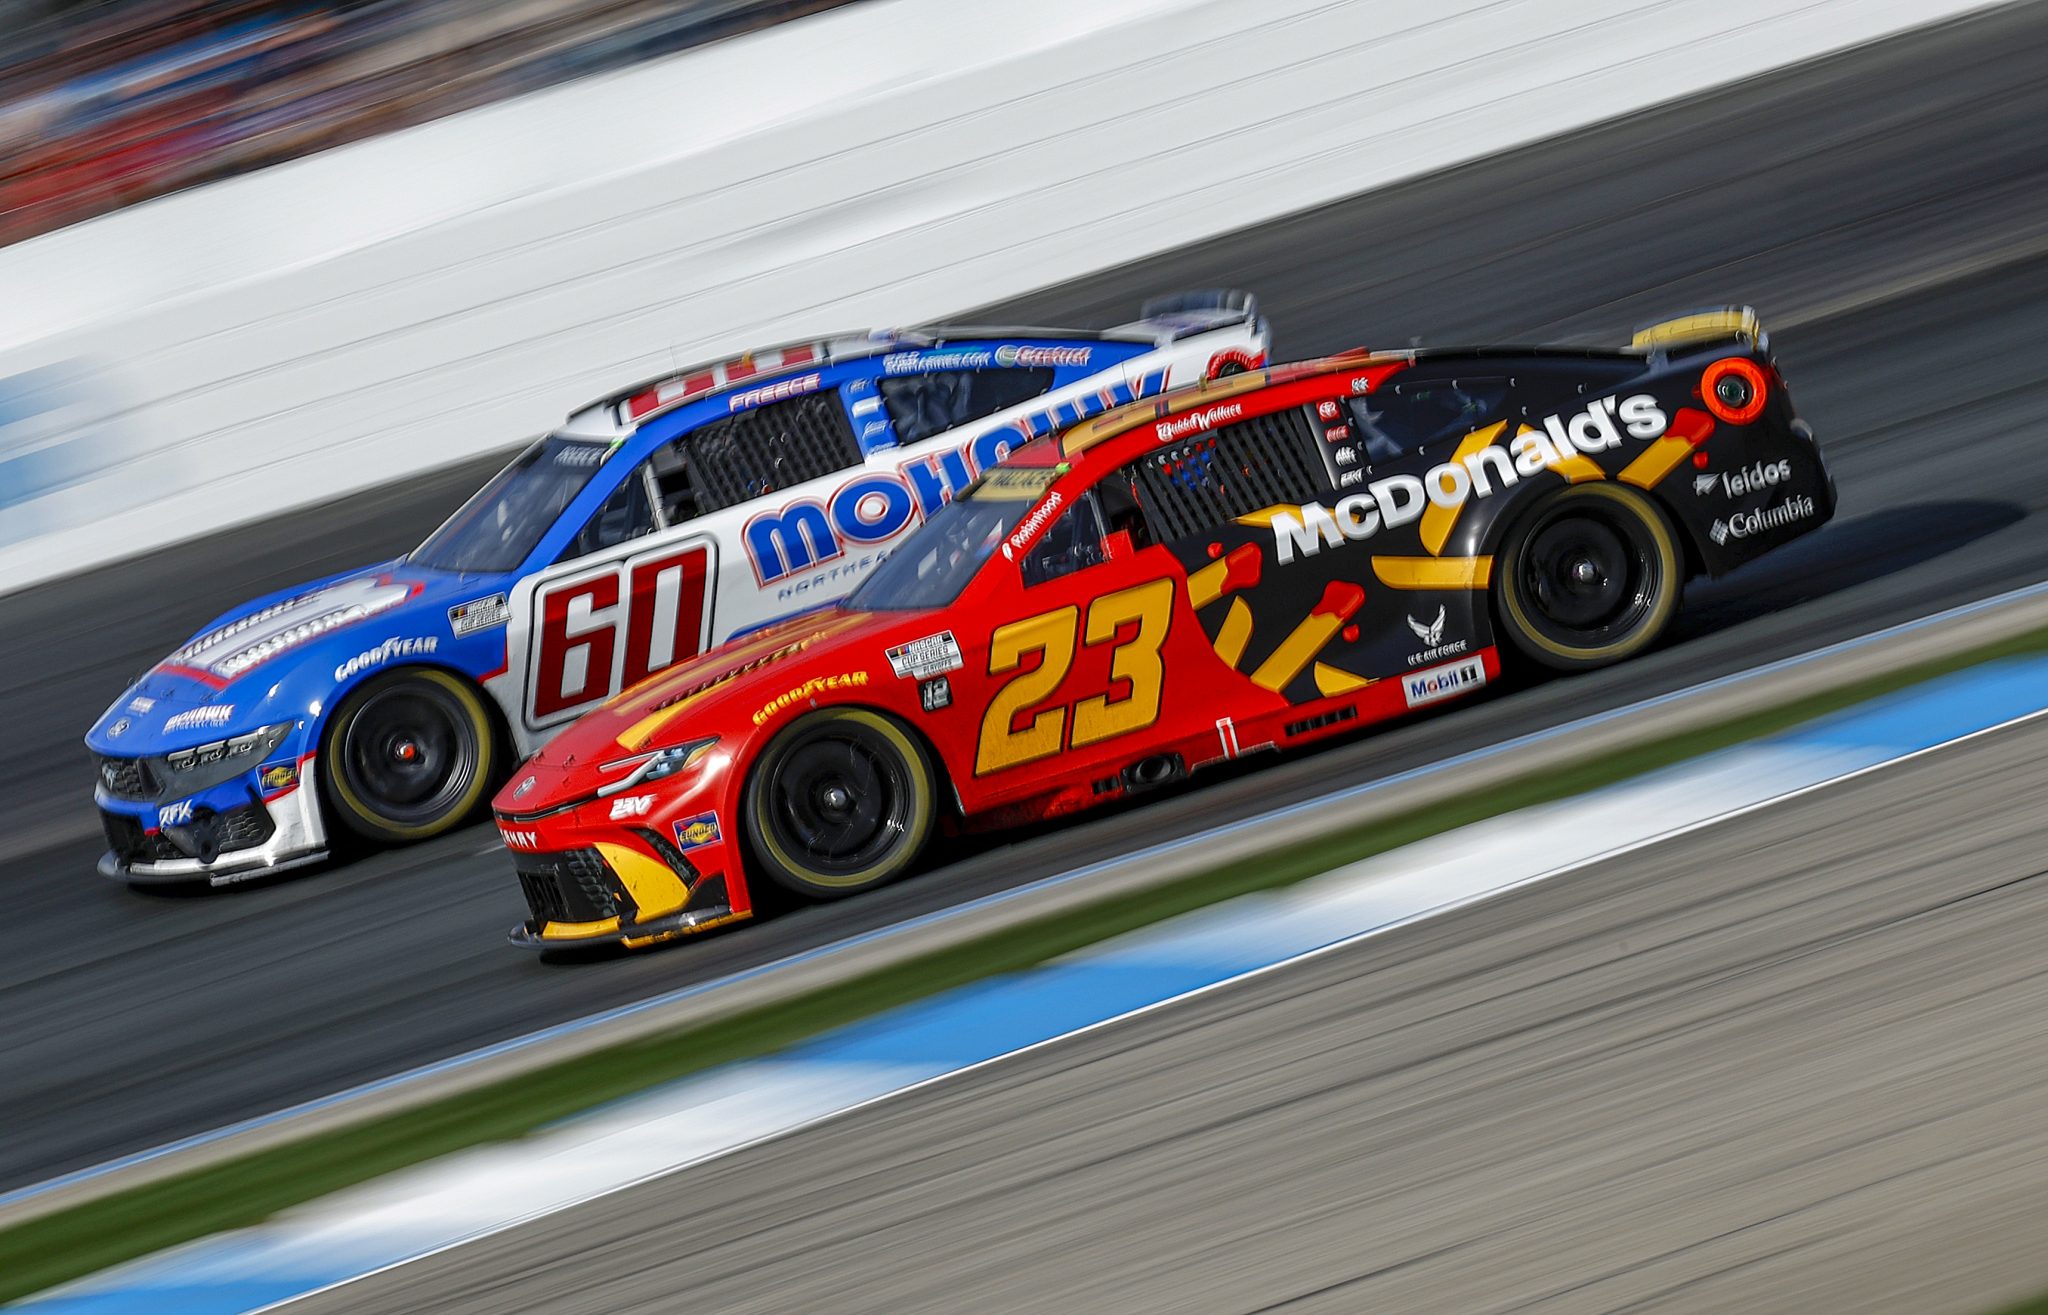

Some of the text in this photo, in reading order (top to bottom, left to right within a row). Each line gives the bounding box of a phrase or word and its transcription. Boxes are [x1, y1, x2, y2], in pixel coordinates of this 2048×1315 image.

[1270, 394, 1667, 565] McDonald's
[1722, 459, 1791, 499] leidos
[1011, 491, 1062, 549] Robinhood
[1729, 494, 1814, 538] Columbia
[778, 549, 896, 601] NORTHEA
[535, 547, 707, 717] 60
[908, 635, 943, 653] NASCAR
[335, 635, 438, 682] GOODYEAR
[901, 645, 949, 668] CUP SERIES
[923, 658, 952, 674] PLAYOFFS
[975, 576, 1174, 776] 23
[753, 671, 868, 726] GOODYEAR
[1411, 671, 1458, 698] Mobil
[679, 823, 719, 842] SUNOCO
